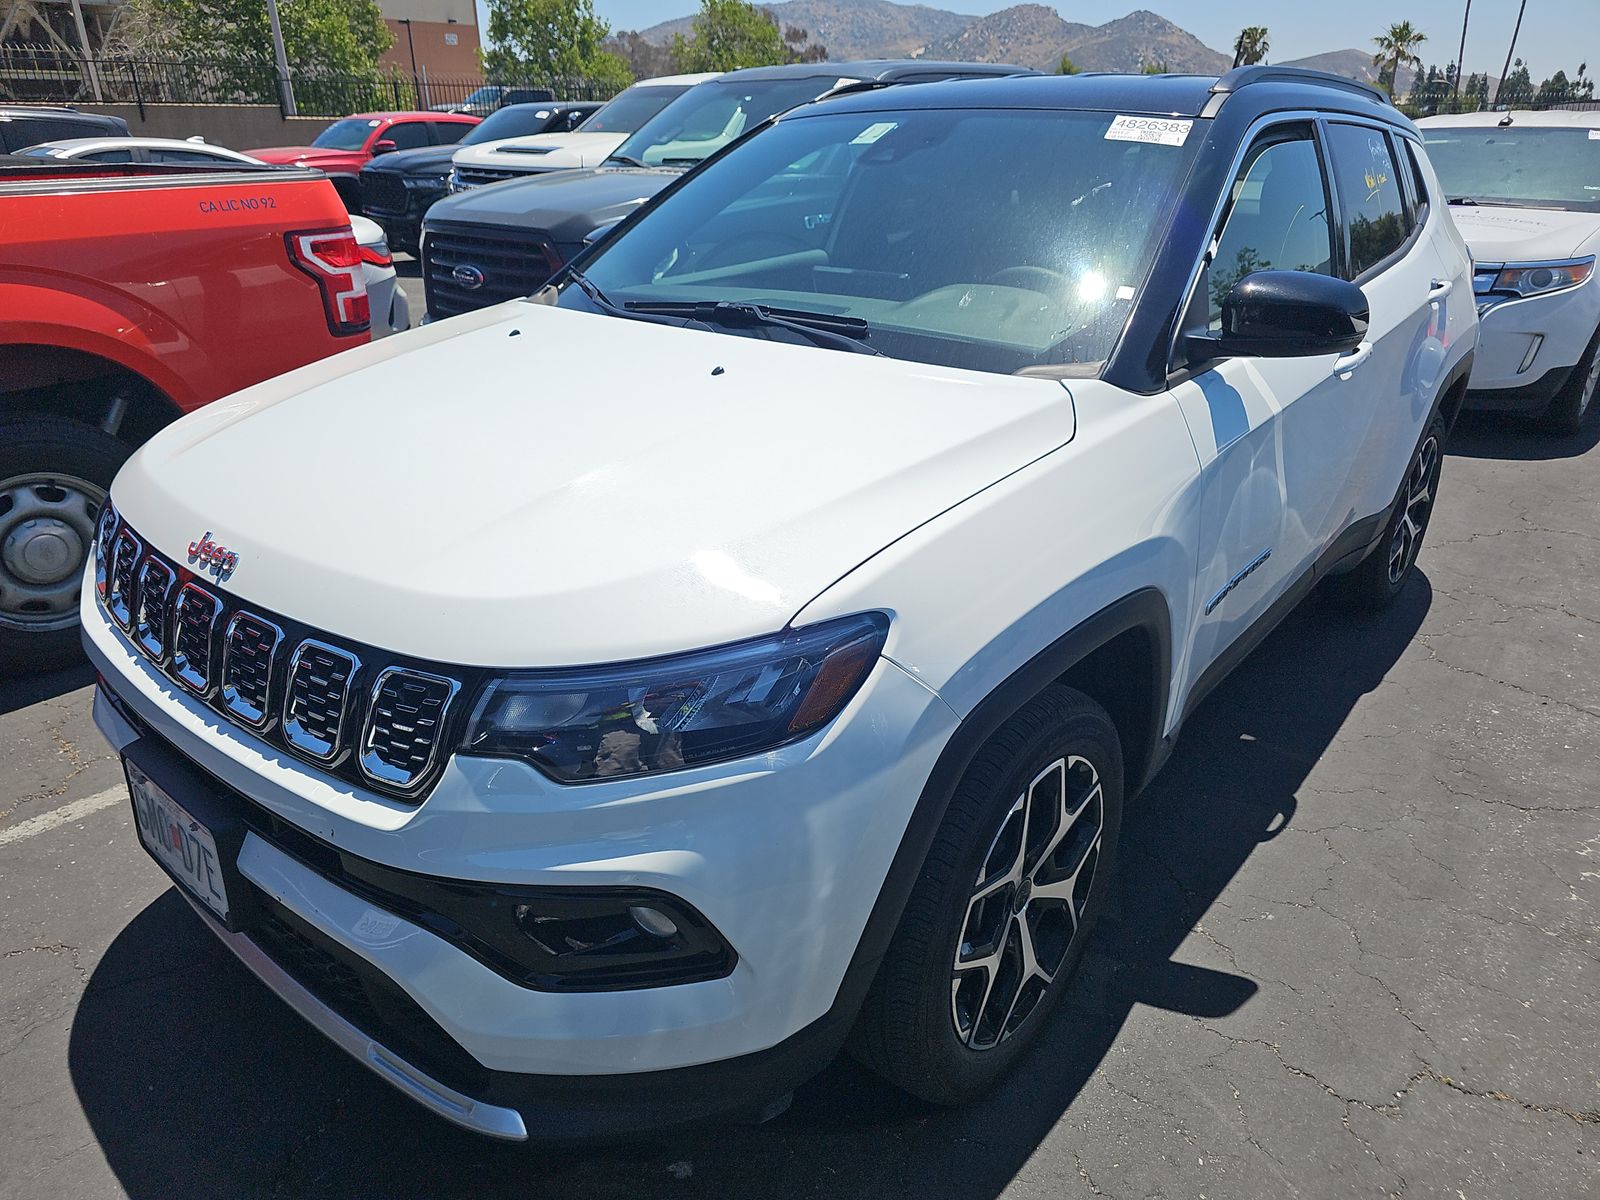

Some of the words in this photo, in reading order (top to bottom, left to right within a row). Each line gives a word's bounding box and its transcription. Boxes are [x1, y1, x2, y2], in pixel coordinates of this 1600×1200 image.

[1115, 119, 1191, 134] 4826383
[199, 201, 219, 213] CA
[219, 199, 240, 212] LIC
[240, 198, 259, 210] NO
[260, 197, 276, 209] 92
[187, 531, 240, 586] Jeep
